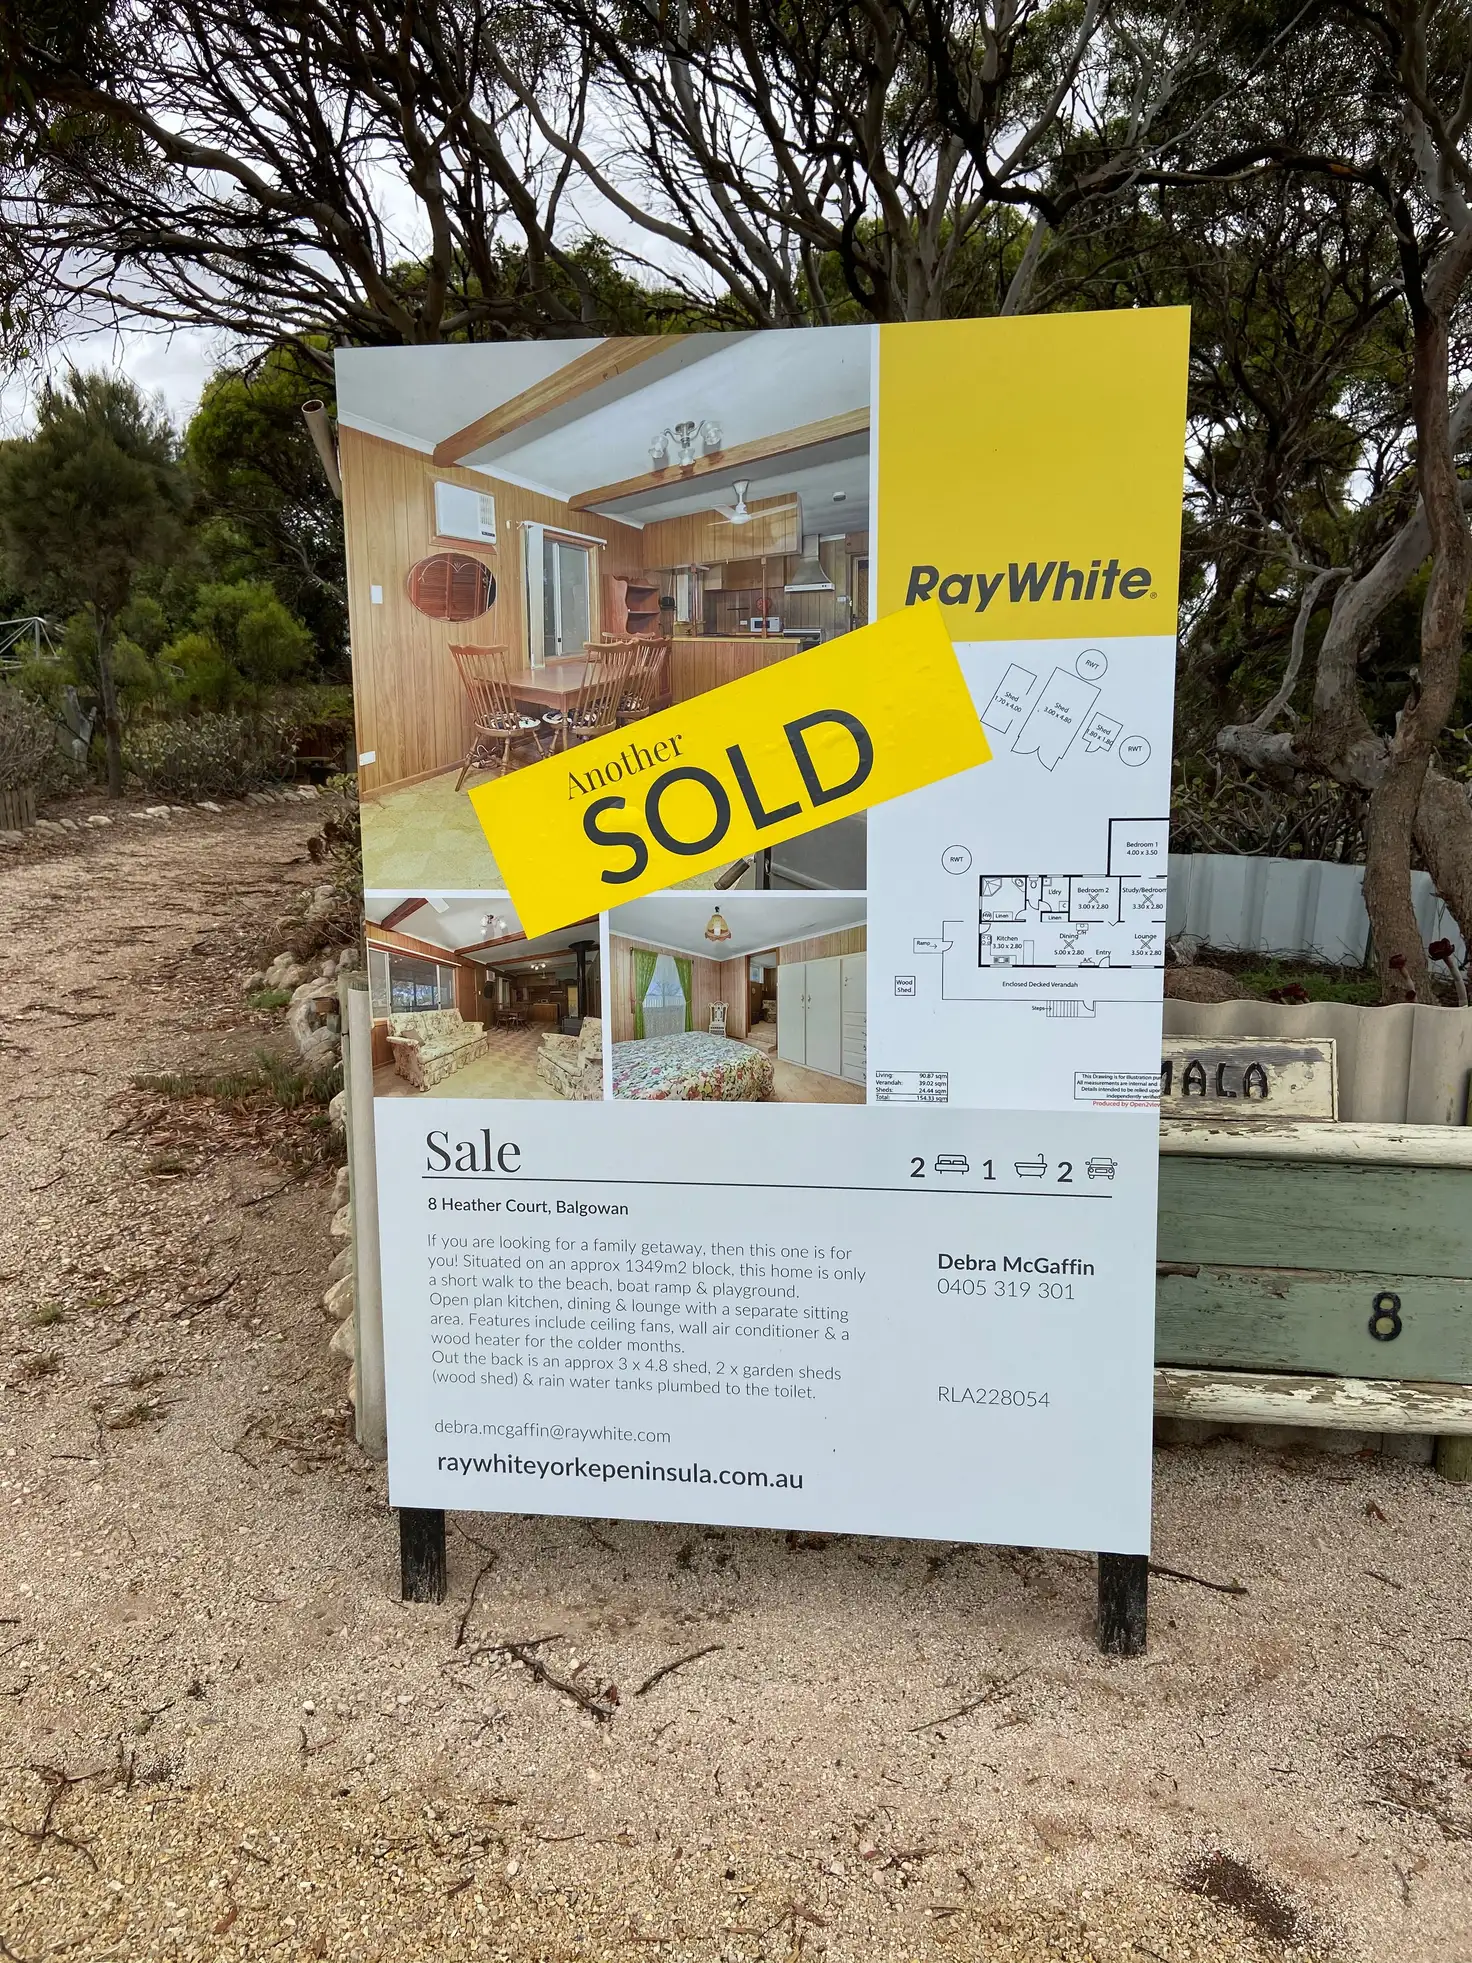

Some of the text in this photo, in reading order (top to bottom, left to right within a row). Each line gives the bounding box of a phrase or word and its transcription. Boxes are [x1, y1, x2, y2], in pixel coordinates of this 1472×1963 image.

[1085, 659, 1099, 670] RWT
[1004, 691, 1020, 702] Shed
[1054, 702, 1070, 714] Shed
[1096, 724, 1111, 736] Shed
[567, 732, 683, 800] Another
[583, 708, 874, 885] SOLD
[425, 1128, 522, 1173] Sale
[910, 1157, 1073, 1183] 2 1 2
[428, 1197, 628, 1217] 8 Heather Court, Balgowan
[428, 1234, 852, 1260] If you are looking for a family getaway, then this one is for
[428, 1254, 866, 1283] you! Situated on an approx 1349m2 block, this home is only
[938, 1253, 1094, 1276] Debra McGaffin
[429, 1273, 799, 1299] a short walk to the beach, boat ramp & playground.
[937, 1278, 1075, 1300] 0405 319 301
[430, 1292, 849, 1323] Open plan kitchen, dining & lounge with a separate sitting
[1368, 1291, 1403, 1343] 8
[430, 1313, 849, 1341] area. Features include ceiling fans, wall air conditioner & a
[431, 1332, 685, 1353] wood heater for the colder months.
[432, 1350, 841, 1380] Out the back is an approx 3 x 4.8 shed, 2 x garden sheds
[433, 1369, 815, 1399] (wood shed) & rain water tanks plumbed to the toilet.
[939, 1386, 1050, 1408] RLA228054
[435, 1419, 670, 1443] debra.mcgaffin@raywhite.com
[438, 1453, 803, 1489] raywhiteyorkepeninsula.com.au
